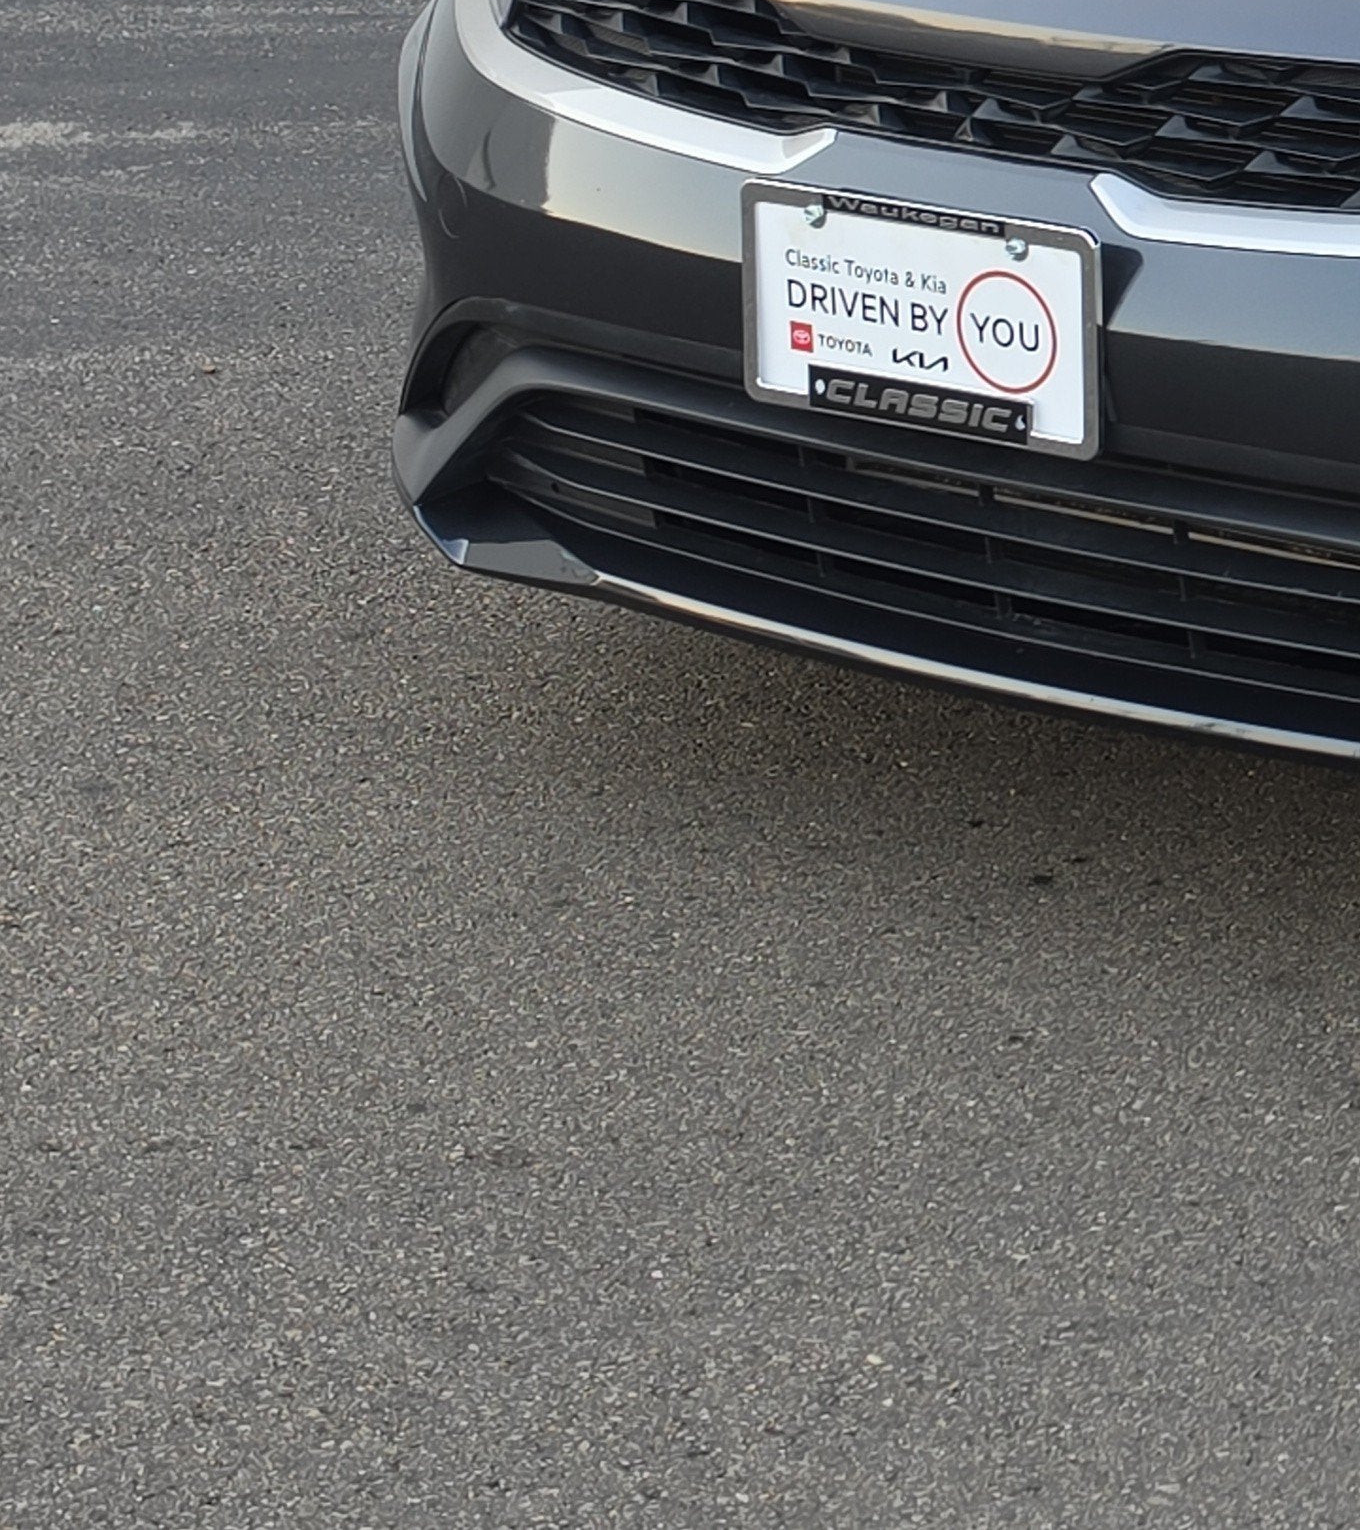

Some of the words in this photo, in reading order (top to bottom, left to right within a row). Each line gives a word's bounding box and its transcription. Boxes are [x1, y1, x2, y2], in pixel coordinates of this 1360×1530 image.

[828, 195, 1000, 234] Waukegan
[785, 248, 840, 275] Classic
[844, 259, 899, 285] Toyota
[905, 271, 915, 288] &
[921, 273, 947, 295] Kia
[787, 279, 899, 327] DRIVEN
[911, 302, 948, 335] BY
[970, 312, 1040, 352] YOU
[818, 333, 873, 357] TOYOTA
[892, 348, 949, 372] KIA
[825, 378, 1013, 433] CLASSIC
